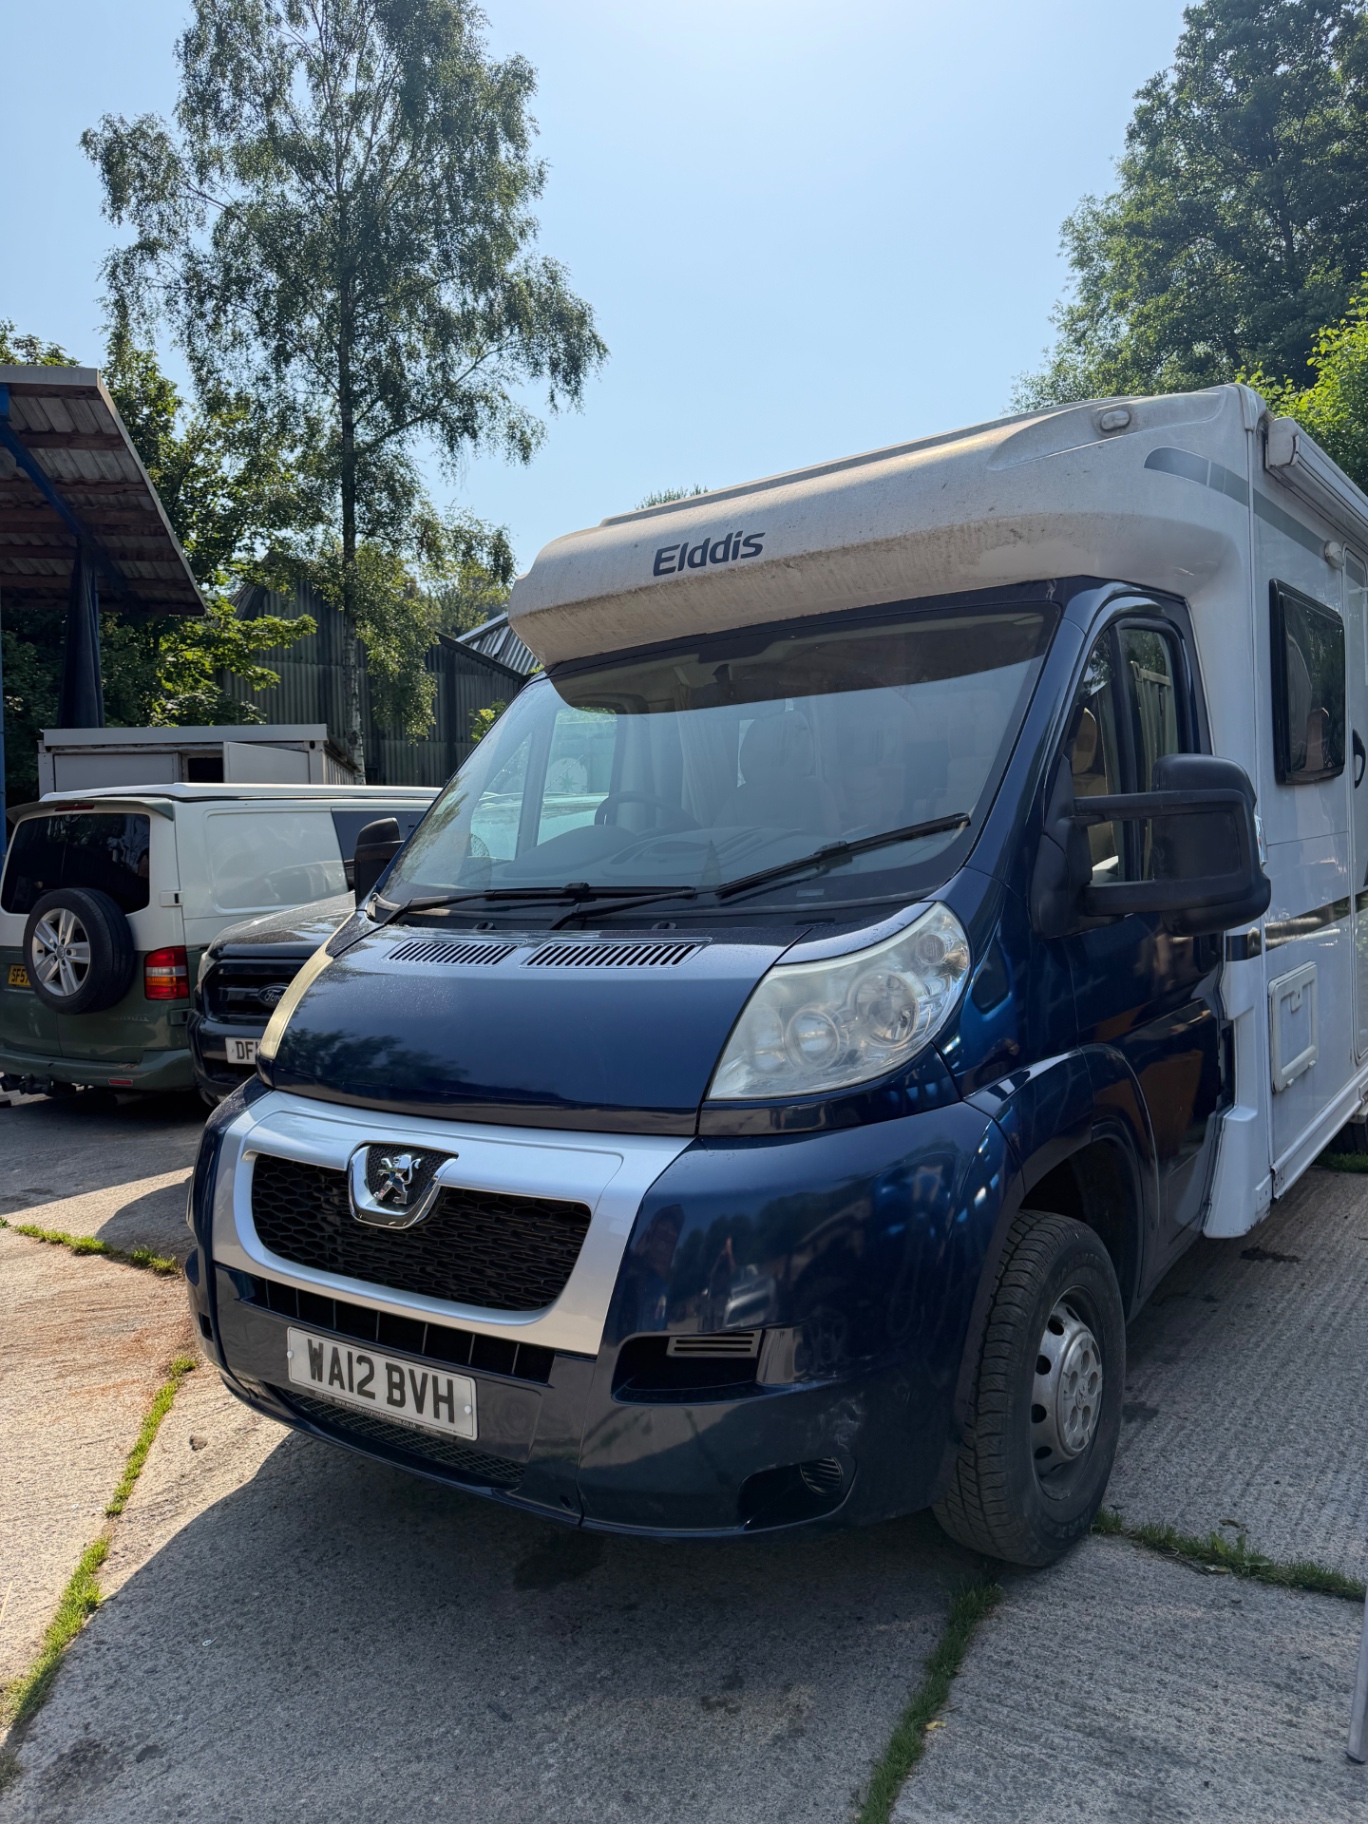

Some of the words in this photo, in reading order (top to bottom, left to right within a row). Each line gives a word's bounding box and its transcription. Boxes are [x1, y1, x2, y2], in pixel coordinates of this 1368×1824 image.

[653, 530, 766, 576] Elddis
[307, 1338, 376, 1400] WA12
[385, 1361, 455, 1424] BVH
